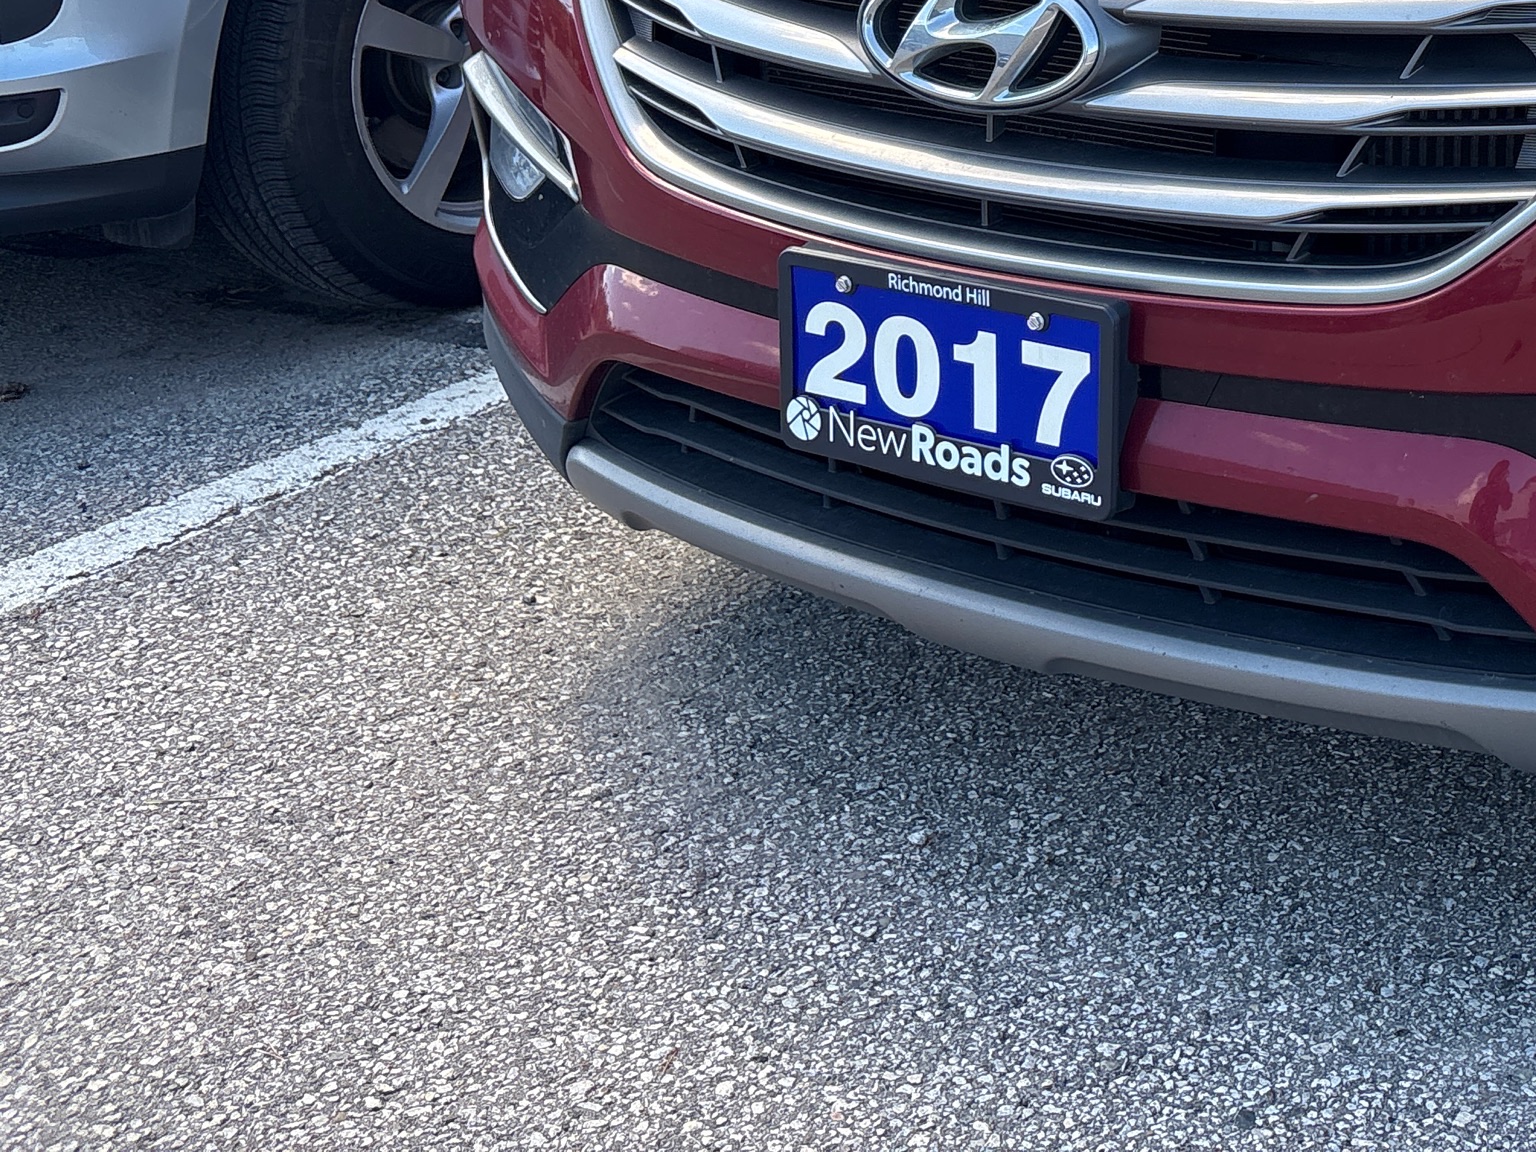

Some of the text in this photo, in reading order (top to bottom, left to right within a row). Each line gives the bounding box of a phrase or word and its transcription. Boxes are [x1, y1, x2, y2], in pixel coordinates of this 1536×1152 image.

[887, 272, 991, 308] Richmond Hill
[803, 300, 1092, 448] 2017
[1041, 482, 1102, 508] SUBARU
